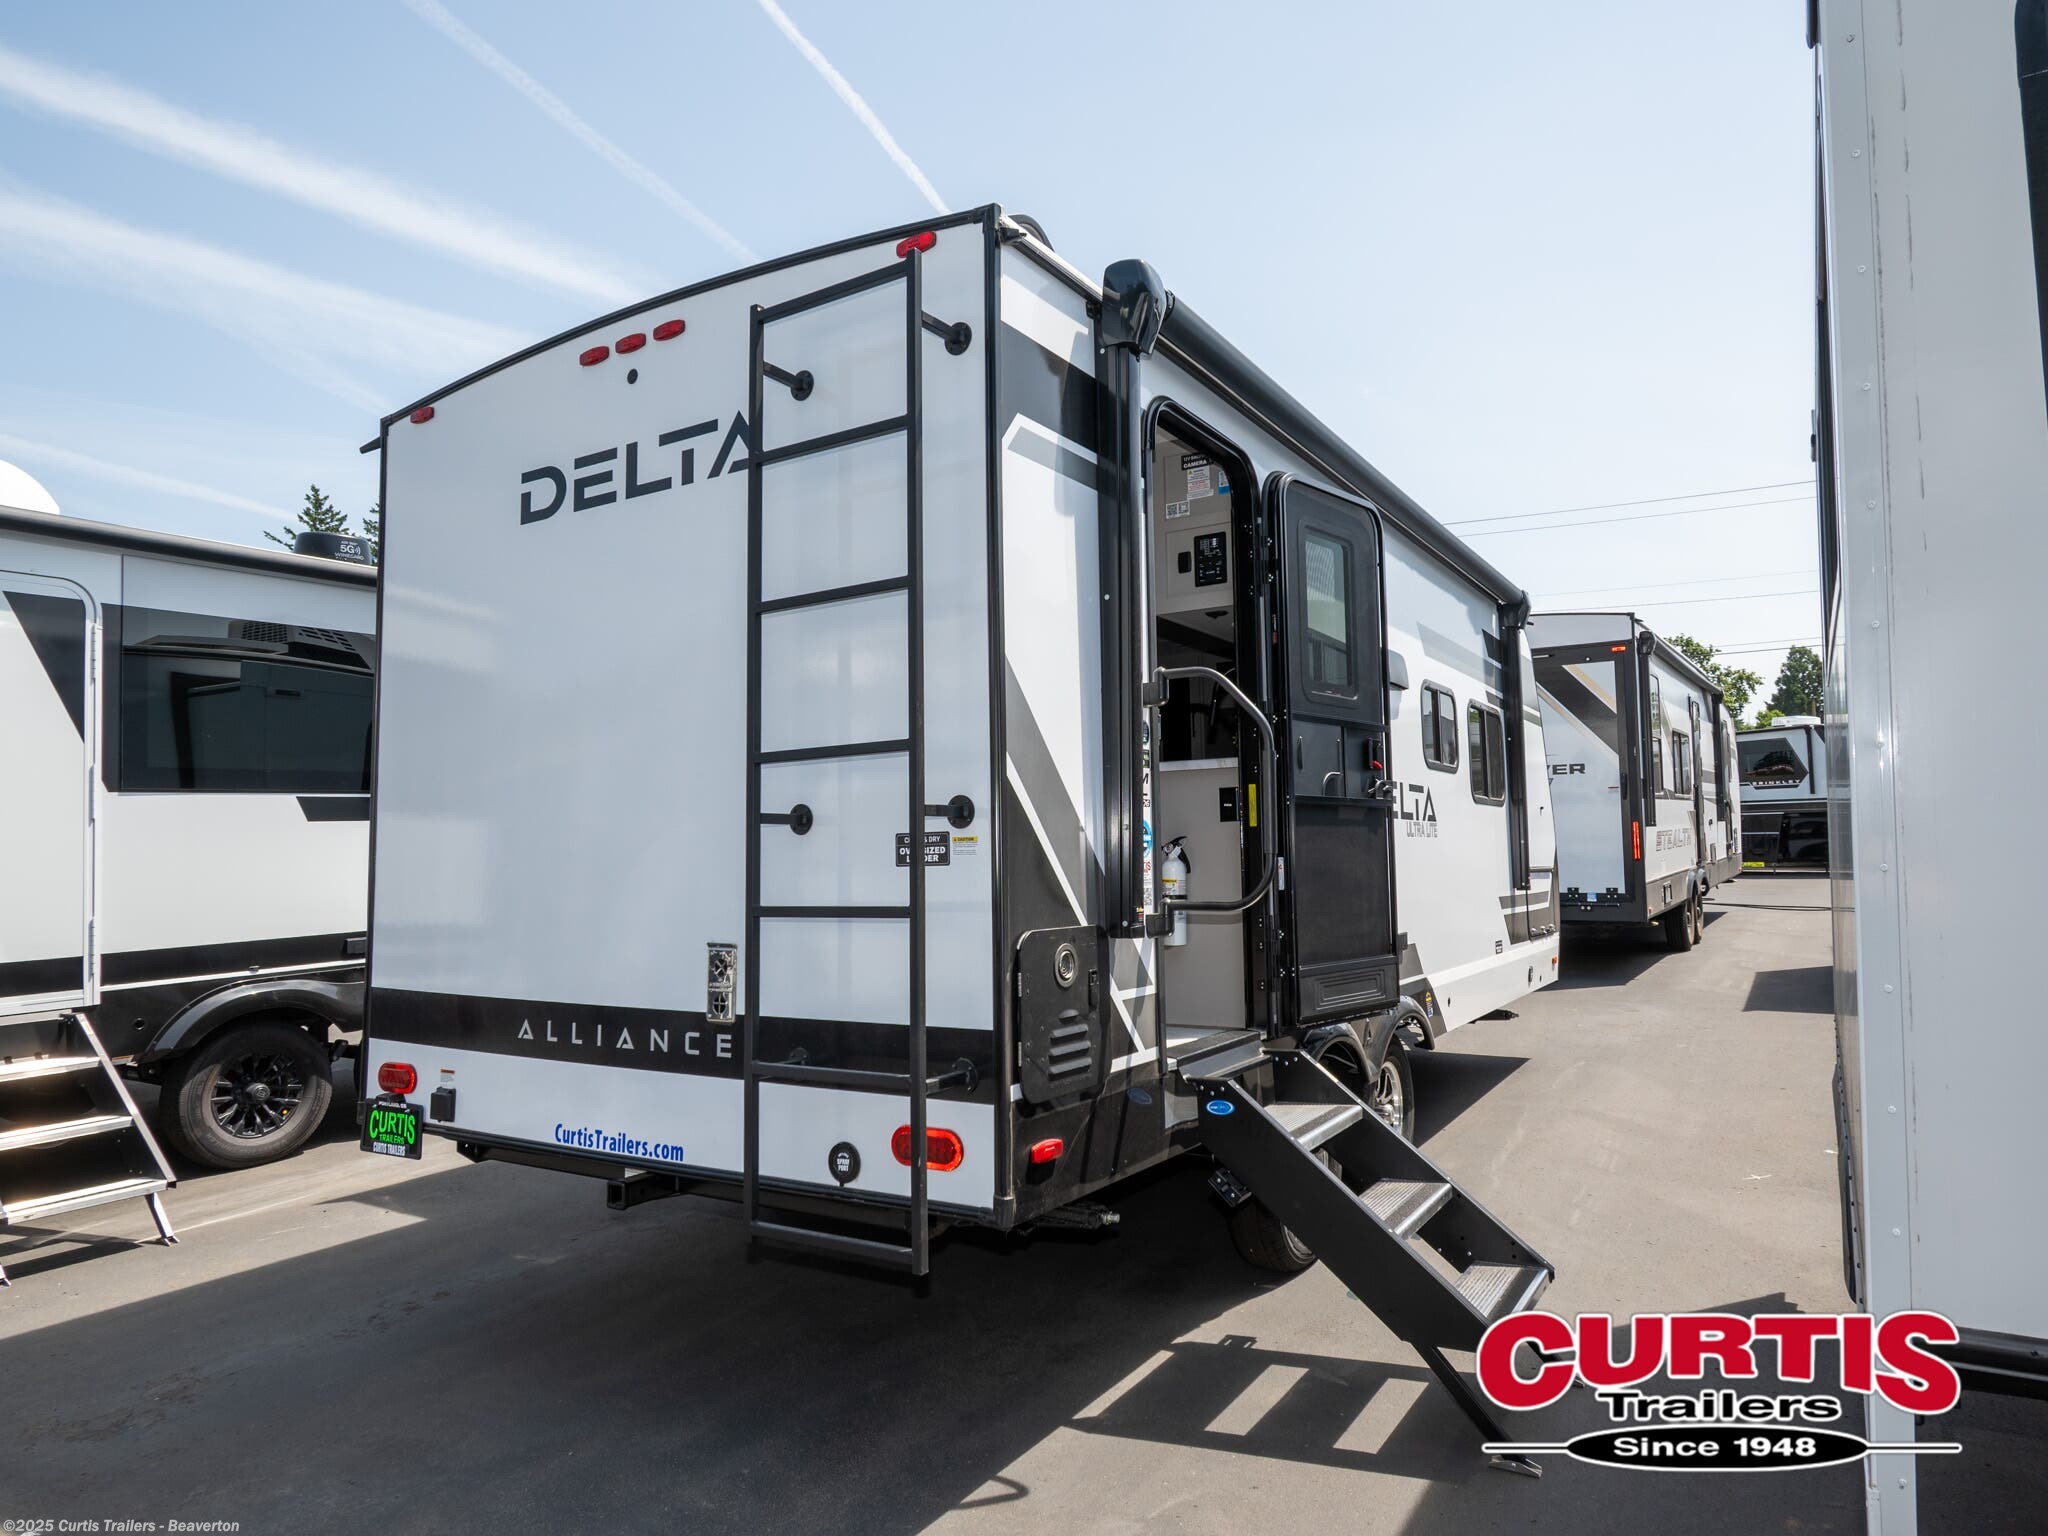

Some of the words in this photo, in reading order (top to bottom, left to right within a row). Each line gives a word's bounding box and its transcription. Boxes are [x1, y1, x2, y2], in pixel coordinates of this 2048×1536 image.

[339, 544, 355, 555] 5G
[1547, 763, 1586, 775] ER
[1392, 781, 1437, 822] ELTA
[928, 835, 941, 843] DRY
[517, 1018, 733, 1060] ALLIANCE
[369, 1109, 416, 1145] CURTIS
[379, 1133, 405, 1146] TRAILERS
[554, 1122, 685, 1162] CurtisTrailers.com
